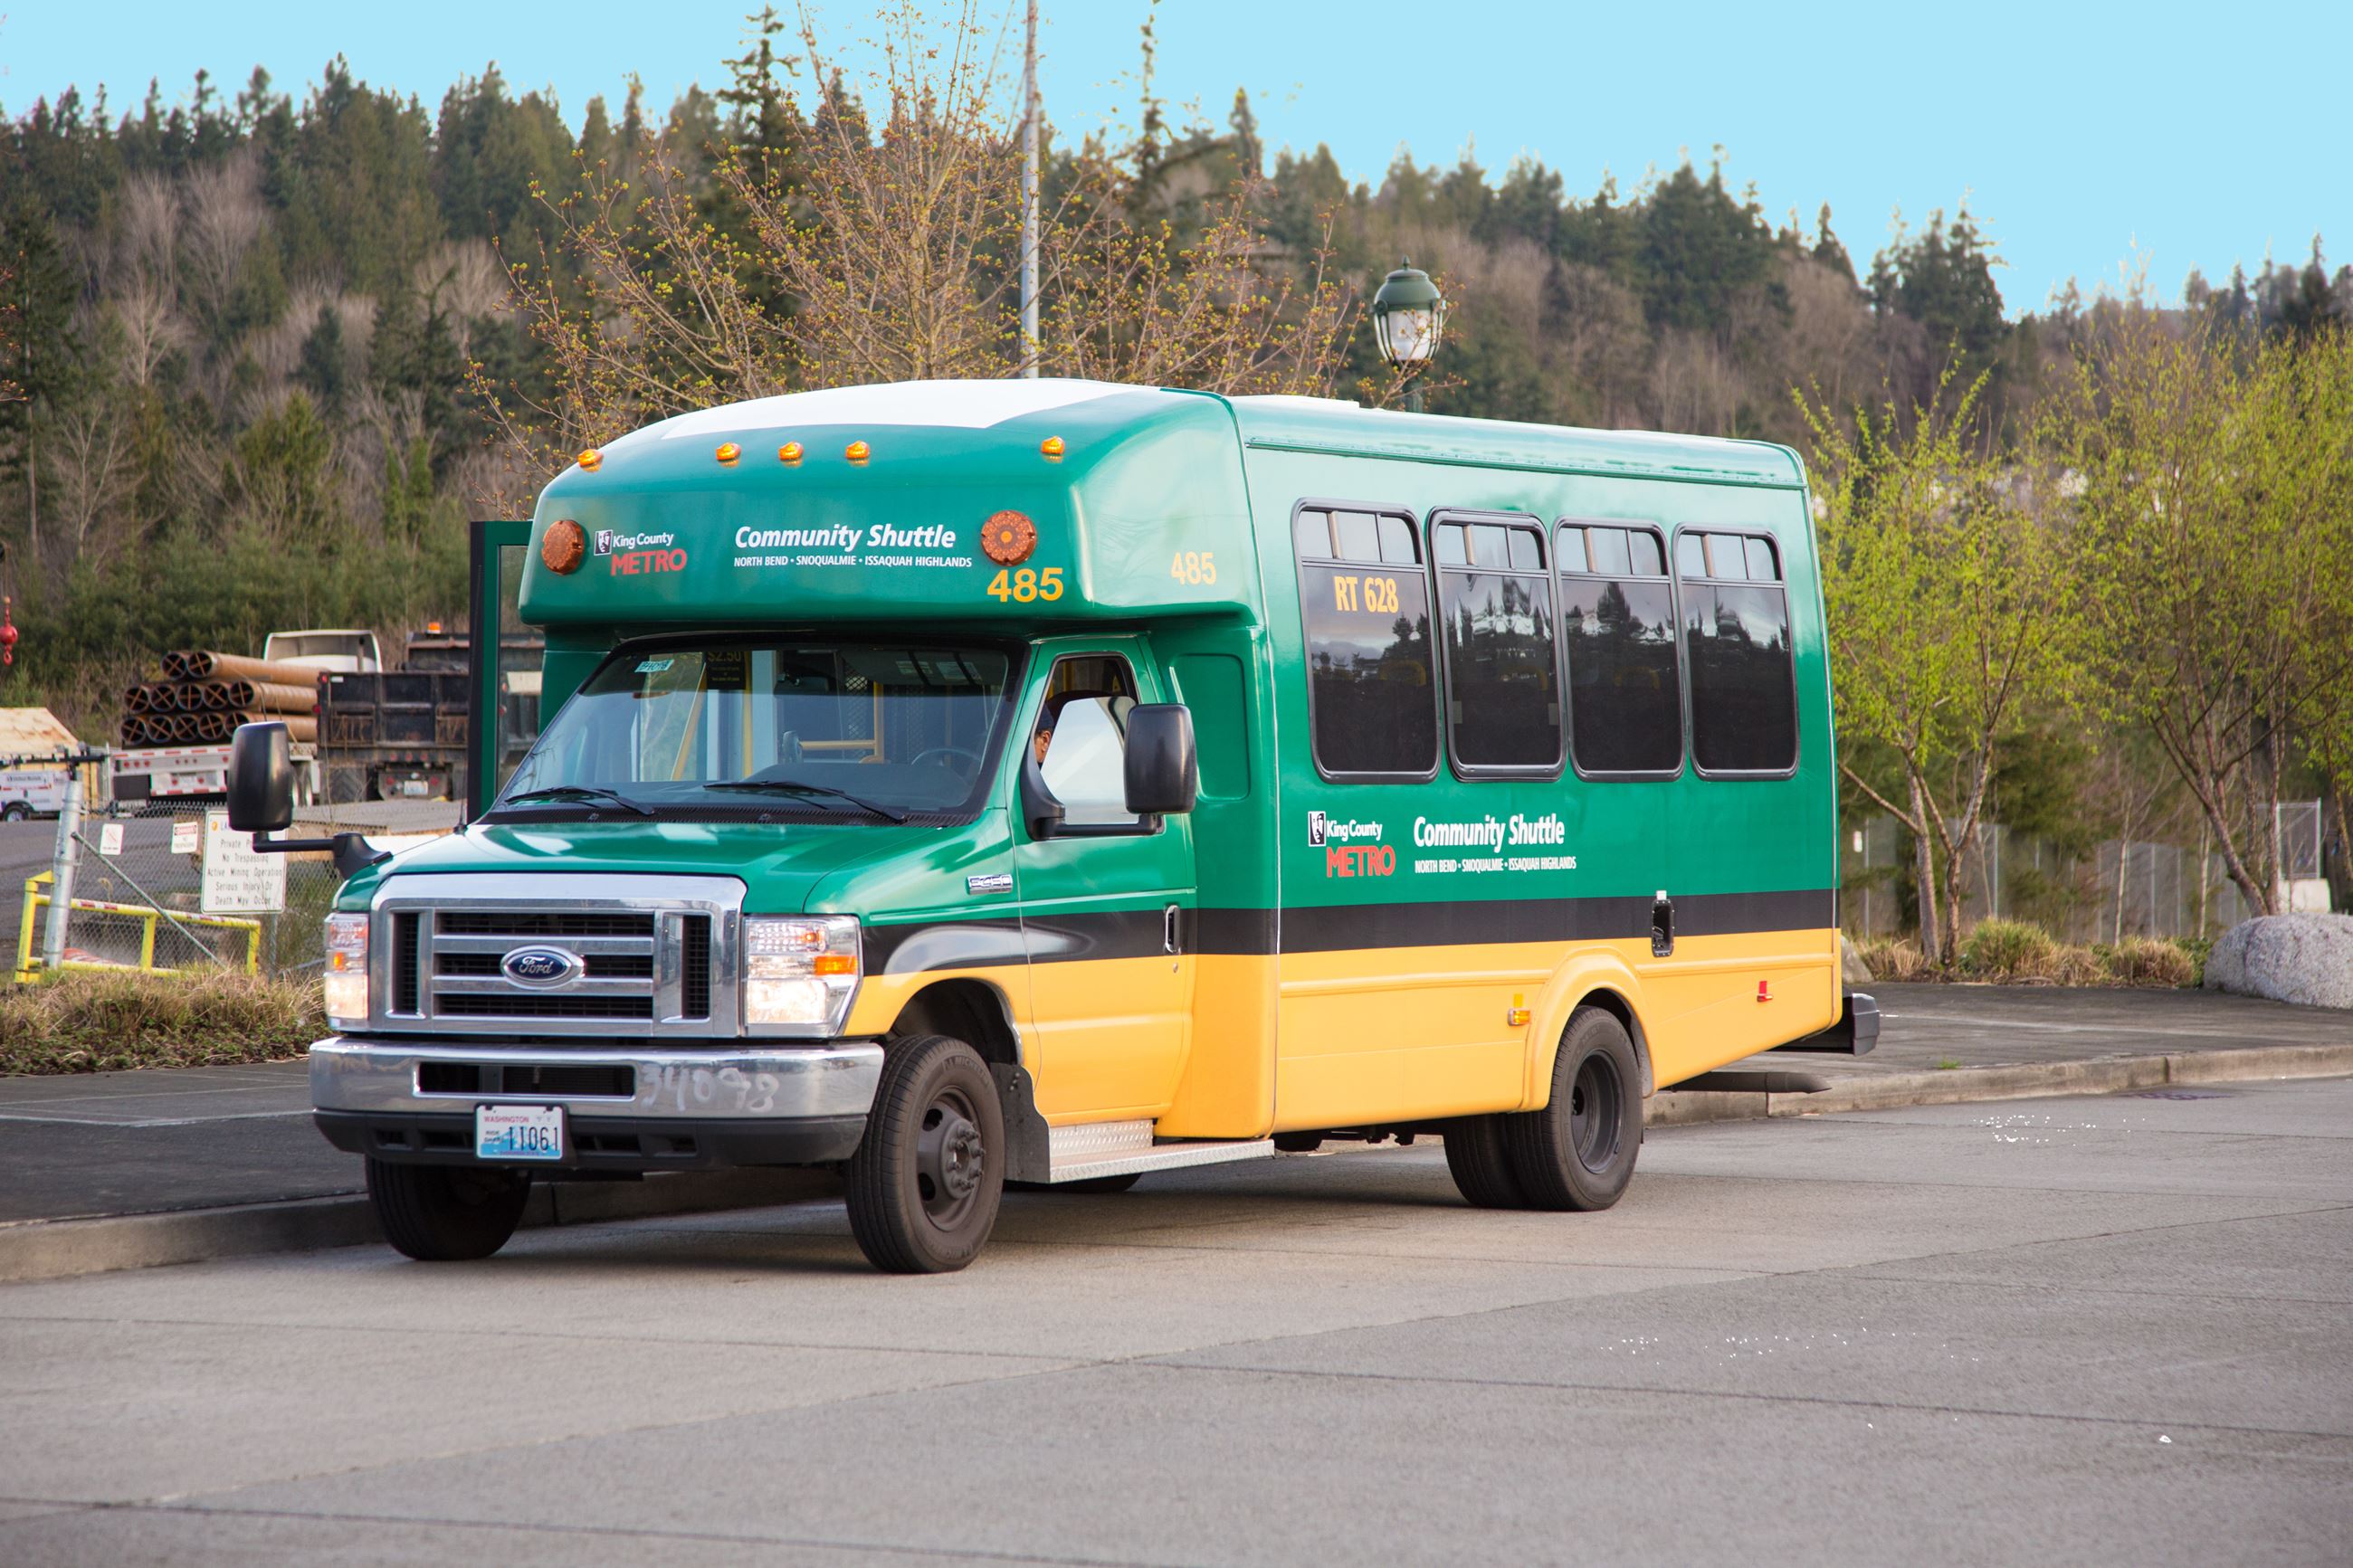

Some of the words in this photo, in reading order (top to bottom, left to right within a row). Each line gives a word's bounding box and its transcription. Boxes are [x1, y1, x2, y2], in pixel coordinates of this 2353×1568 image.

[613, 535, 635, 549] King
[636, 532, 674, 546] County
[735, 523, 862, 552] Community
[866, 523, 957, 548] Shuttle
[610, 548, 688, 576] METRO
[734, 556, 763, 567] NORTH
[765, 556, 789, 566] BEND
[795, 555, 857, 567] SNOQUALMIE
[864, 556, 913, 567] ISSAQUAH
[915, 556, 973, 567] HIGHLANDS
[1170, 551, 1216, 585] 485
[986, 567, 1064, 603] 485
[1333, 575, 1358, 612] RT
[1364, 576, 1399, 613] 628
[1326, 820, 1349, 841] King
[1348, 819, 1383, 841] County
[1414, 814, 1507, 853] Community
[1508, 813, 1566, 845] Shuttle
[1326, 844, 1396, 878] METRO
[1415, 860, 1438, 874] NORTH
[1439, 859, 1457, 873] BEND
[1462, 858, 1504, 874] SNOQUALMIE
[1509, 857, 1539, 872] ISSAQUAH
[1540, 855, 1577, 870] HIGHLANDS
[519, 955, 554, 974] Ford
[509, 1126, 559, 1152] 11061
